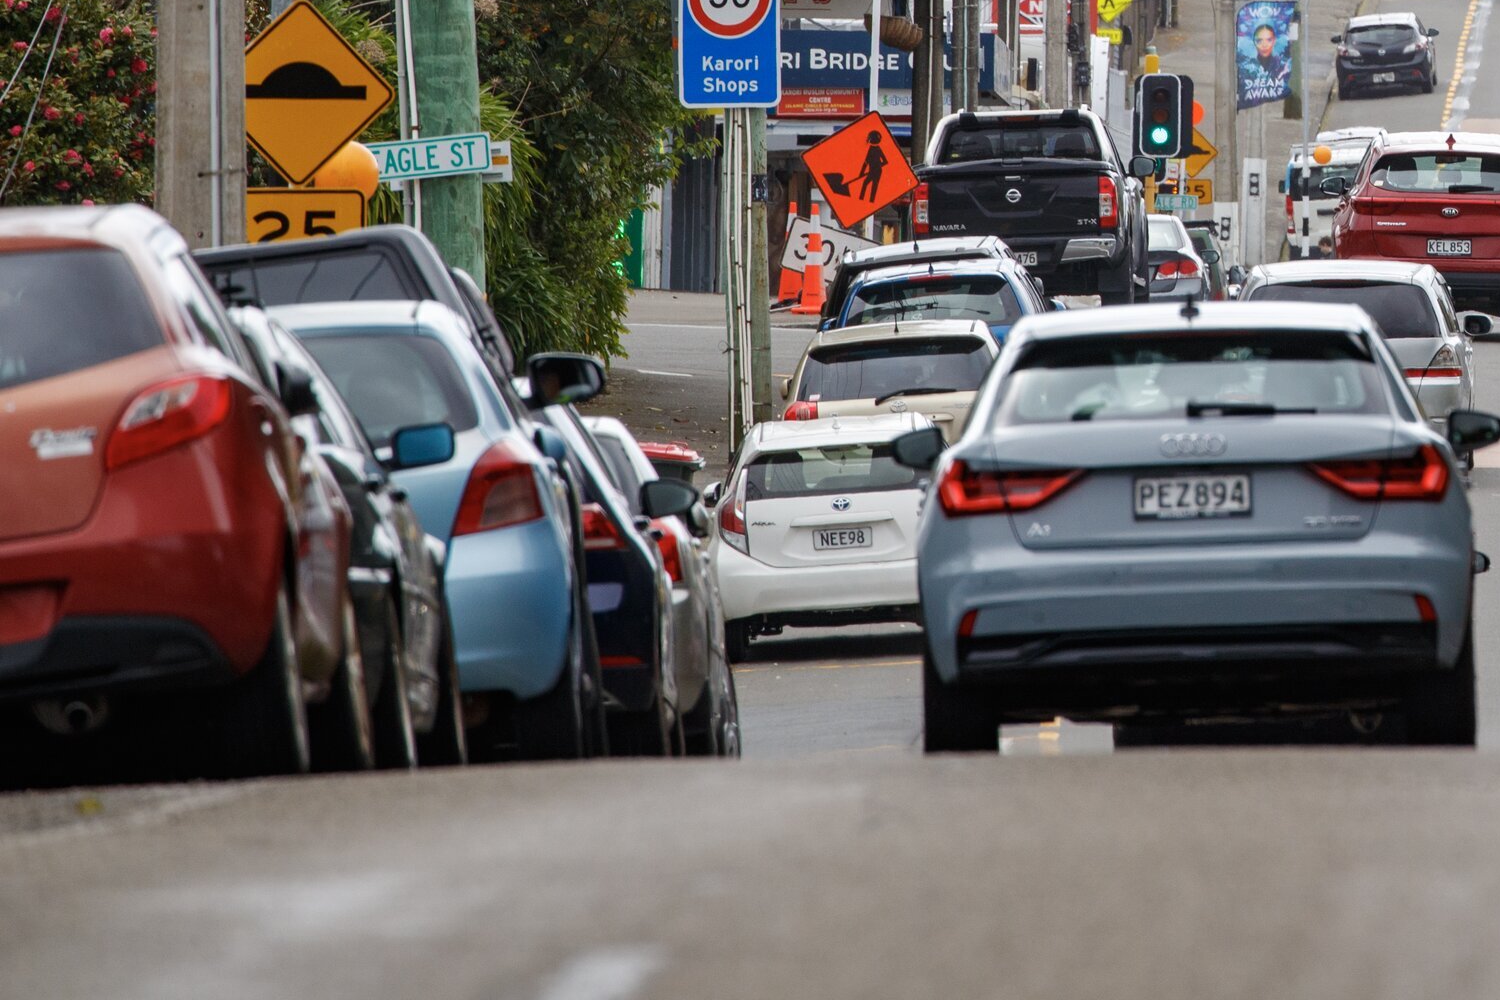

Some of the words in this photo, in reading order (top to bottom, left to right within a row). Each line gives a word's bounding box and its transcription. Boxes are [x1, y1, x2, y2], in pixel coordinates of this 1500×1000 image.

[1249, 6, 1281, 19] WOW
[702, 55, 759, 72] Karori
[809, 48, 899, 70] BRIDGE
[703, 77, 759, 96] Shops
[808, 96, 832, 104] CENTRE
[450, 141, 476, 167] ST
[253, 210, 336, 243] 25
[932, 224, 966, 232] NAVARA
[1428, 241, 1471, 253] KEL853
[1140, 479, 1244, 509] PEZ894
[820, 528, 865, 546] NEE98
